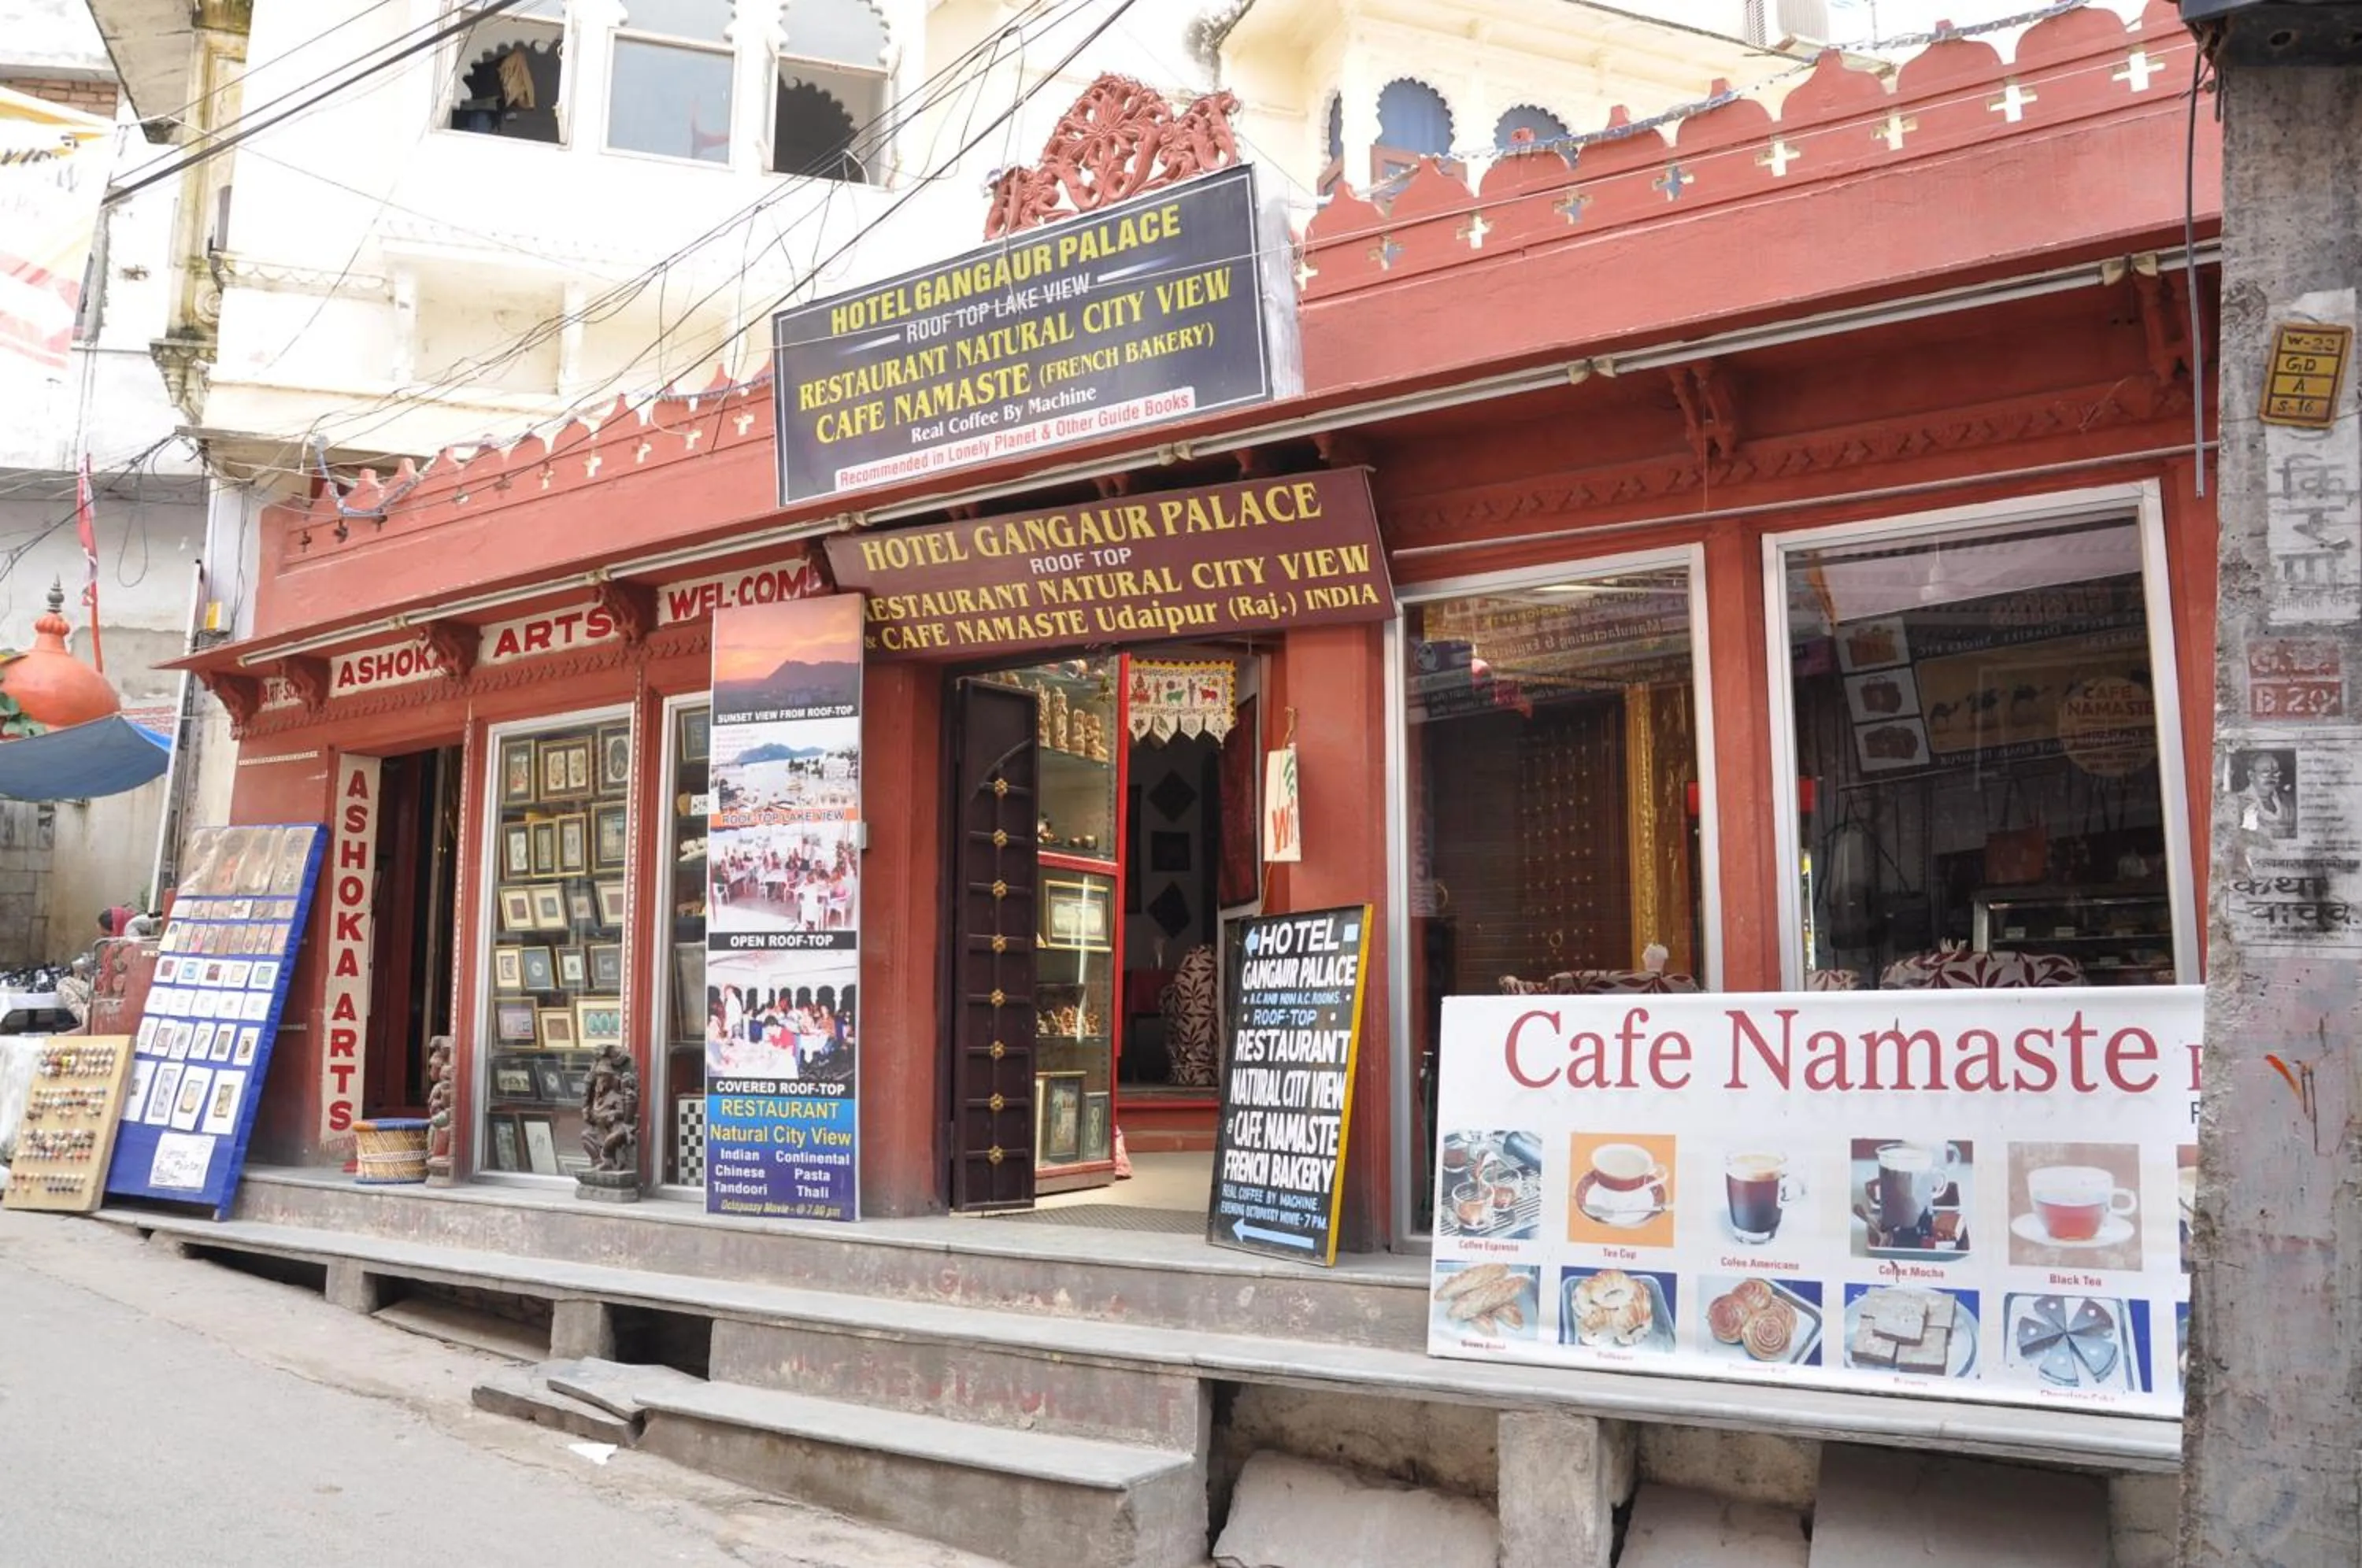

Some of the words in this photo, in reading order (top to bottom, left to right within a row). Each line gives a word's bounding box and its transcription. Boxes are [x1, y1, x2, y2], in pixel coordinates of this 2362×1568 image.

[831, 288, 911, 335] HOTEL
[915, 245, 1054, 305] GANGAUR
[1060, 205, 1181, 267] PALACE
[906, 316, 952, 344] ROOF
[953, 302, 989, 329] TOP
[994, 288, 1039, 318] LAKE
[1043, 272, 1090, 305] VIEW
[799, 342, 950, 411] RESTAURANT
[956, 311, 1074, 368] NATURAL
[1083, 290, 1146, 335] CITY
[1157, 268, 1232, 310] VIEW
[816, 401, 886, 444] CAFE
[894, 364, 1031, 421] NAMASTE
[1038, 346, 1119, 386] (FRENCH
[1126, 325, 1215, 364] BAKERY)
[2293, 378, 2305, 392] A
[911, 421, 944, 443] Real
[949, 408, 999, 436] Coffee
[1004, 405, 1023, 423] By
[1028, 387, 1097, 416] Machine
[841, 453, 929, 486] Recommended
[933, 449, 944, 466] in
[947, 438, 990, 464] Lonely
[994, 427, 1036, 453] Planet
[1041, 423, 1051, 441] &
[1056, 416, 1093, 438] Other
[1098, 406, 1140, 430] Guide
[1145, 394, 1189, 420] Books
[860, 531, 968, 571] HOTEL
[975, 507, 1146, 557] GANGAUR
[1159, 483, 1322, 534] PALACE
[1031, 553, 1085, 574] ROOF
[1090, 548, 1132, 567] TOP
[1039, 568, 1182, 607] NATURAL
[1191, 557, 1266, 590] CITY
[1279, 545, 1371, 580] VIEW
[494, 605, 616, 658] ARTS
[882, 621, 950, 650] CAFE
[957, 612, 1089, 644] NAMASTE
[1095, 600, 1217, 634] Udaipur
[1228, 594, 1298, 621] (Raj.)
[1307, 584, 1379, 610] INDIA
[2068, 701, 2154, 716] NAMASTE
[2082, 686, 2132, 700] CAFE
[717, 712, 753, 723] SUNSET
[756, 711, 778, 721] VIEW
[780, 708, 805, 719] FROM
[808, 705, 853, 717] ROOF-TOP
[336, 769, 369, 978] ASHOKA
[731, 935, 765, 948] OPEN
[768, 934, 834, 947] ROOF-TOP
[1258, 919, 1340, 956] HOTEL
[1299, 954, 1359, 988] PALACE
[1253, 1009, 1317, 1026] ROOF-TOP
[329, 993, 359, 1131] ARTS
[1235, 1030, 1352, 1063] RESTAURANT
[1504, 1007, 1694, 1092] Cafe
[1723, 1008, 2160, 1095] Namaste
[716, 1081, 776, 1094] COVERED
[780, 1082, 846, 1096] ROOF-TOP
[1230, 1068, 1282, 1106] NATURAL
[1283, 1070, 1310, 1108] CITY
[1311, 1071, 1348, 1111] VIEW
[721, 1099, 839, 1119] RESTAURANT
[711, 1124, 768, 1143] Natural
[773, 1126, 806, 1148] City
[812, 1128, 851, 1146] View
[1234, 1111, 1263, 1148] CAFE
[1264, 1114, 1341, 1156] NAMASTE
[715, 1164, 765, 1178] Chinese
[794, 1168, 831, 1182] Pasta
[720, 1148, 760, 1162] Indian
[776, 1150, 850, 1165] Continental
[1224, 1151, 1270, 1185] FRENCH
[1271, 1155, 1336, 1194] BAKERY
[713, 1182, 768, 1196] Tandoori
[797, 1185, 829, 1199] Thali
[1266, 1190, 1277, 1204] BY
[1603, 1248, 1616, 1259] Tea
[2049, 1274, 2079, 1286] Black
[2082, 1274, 2102, 1288] Tea
